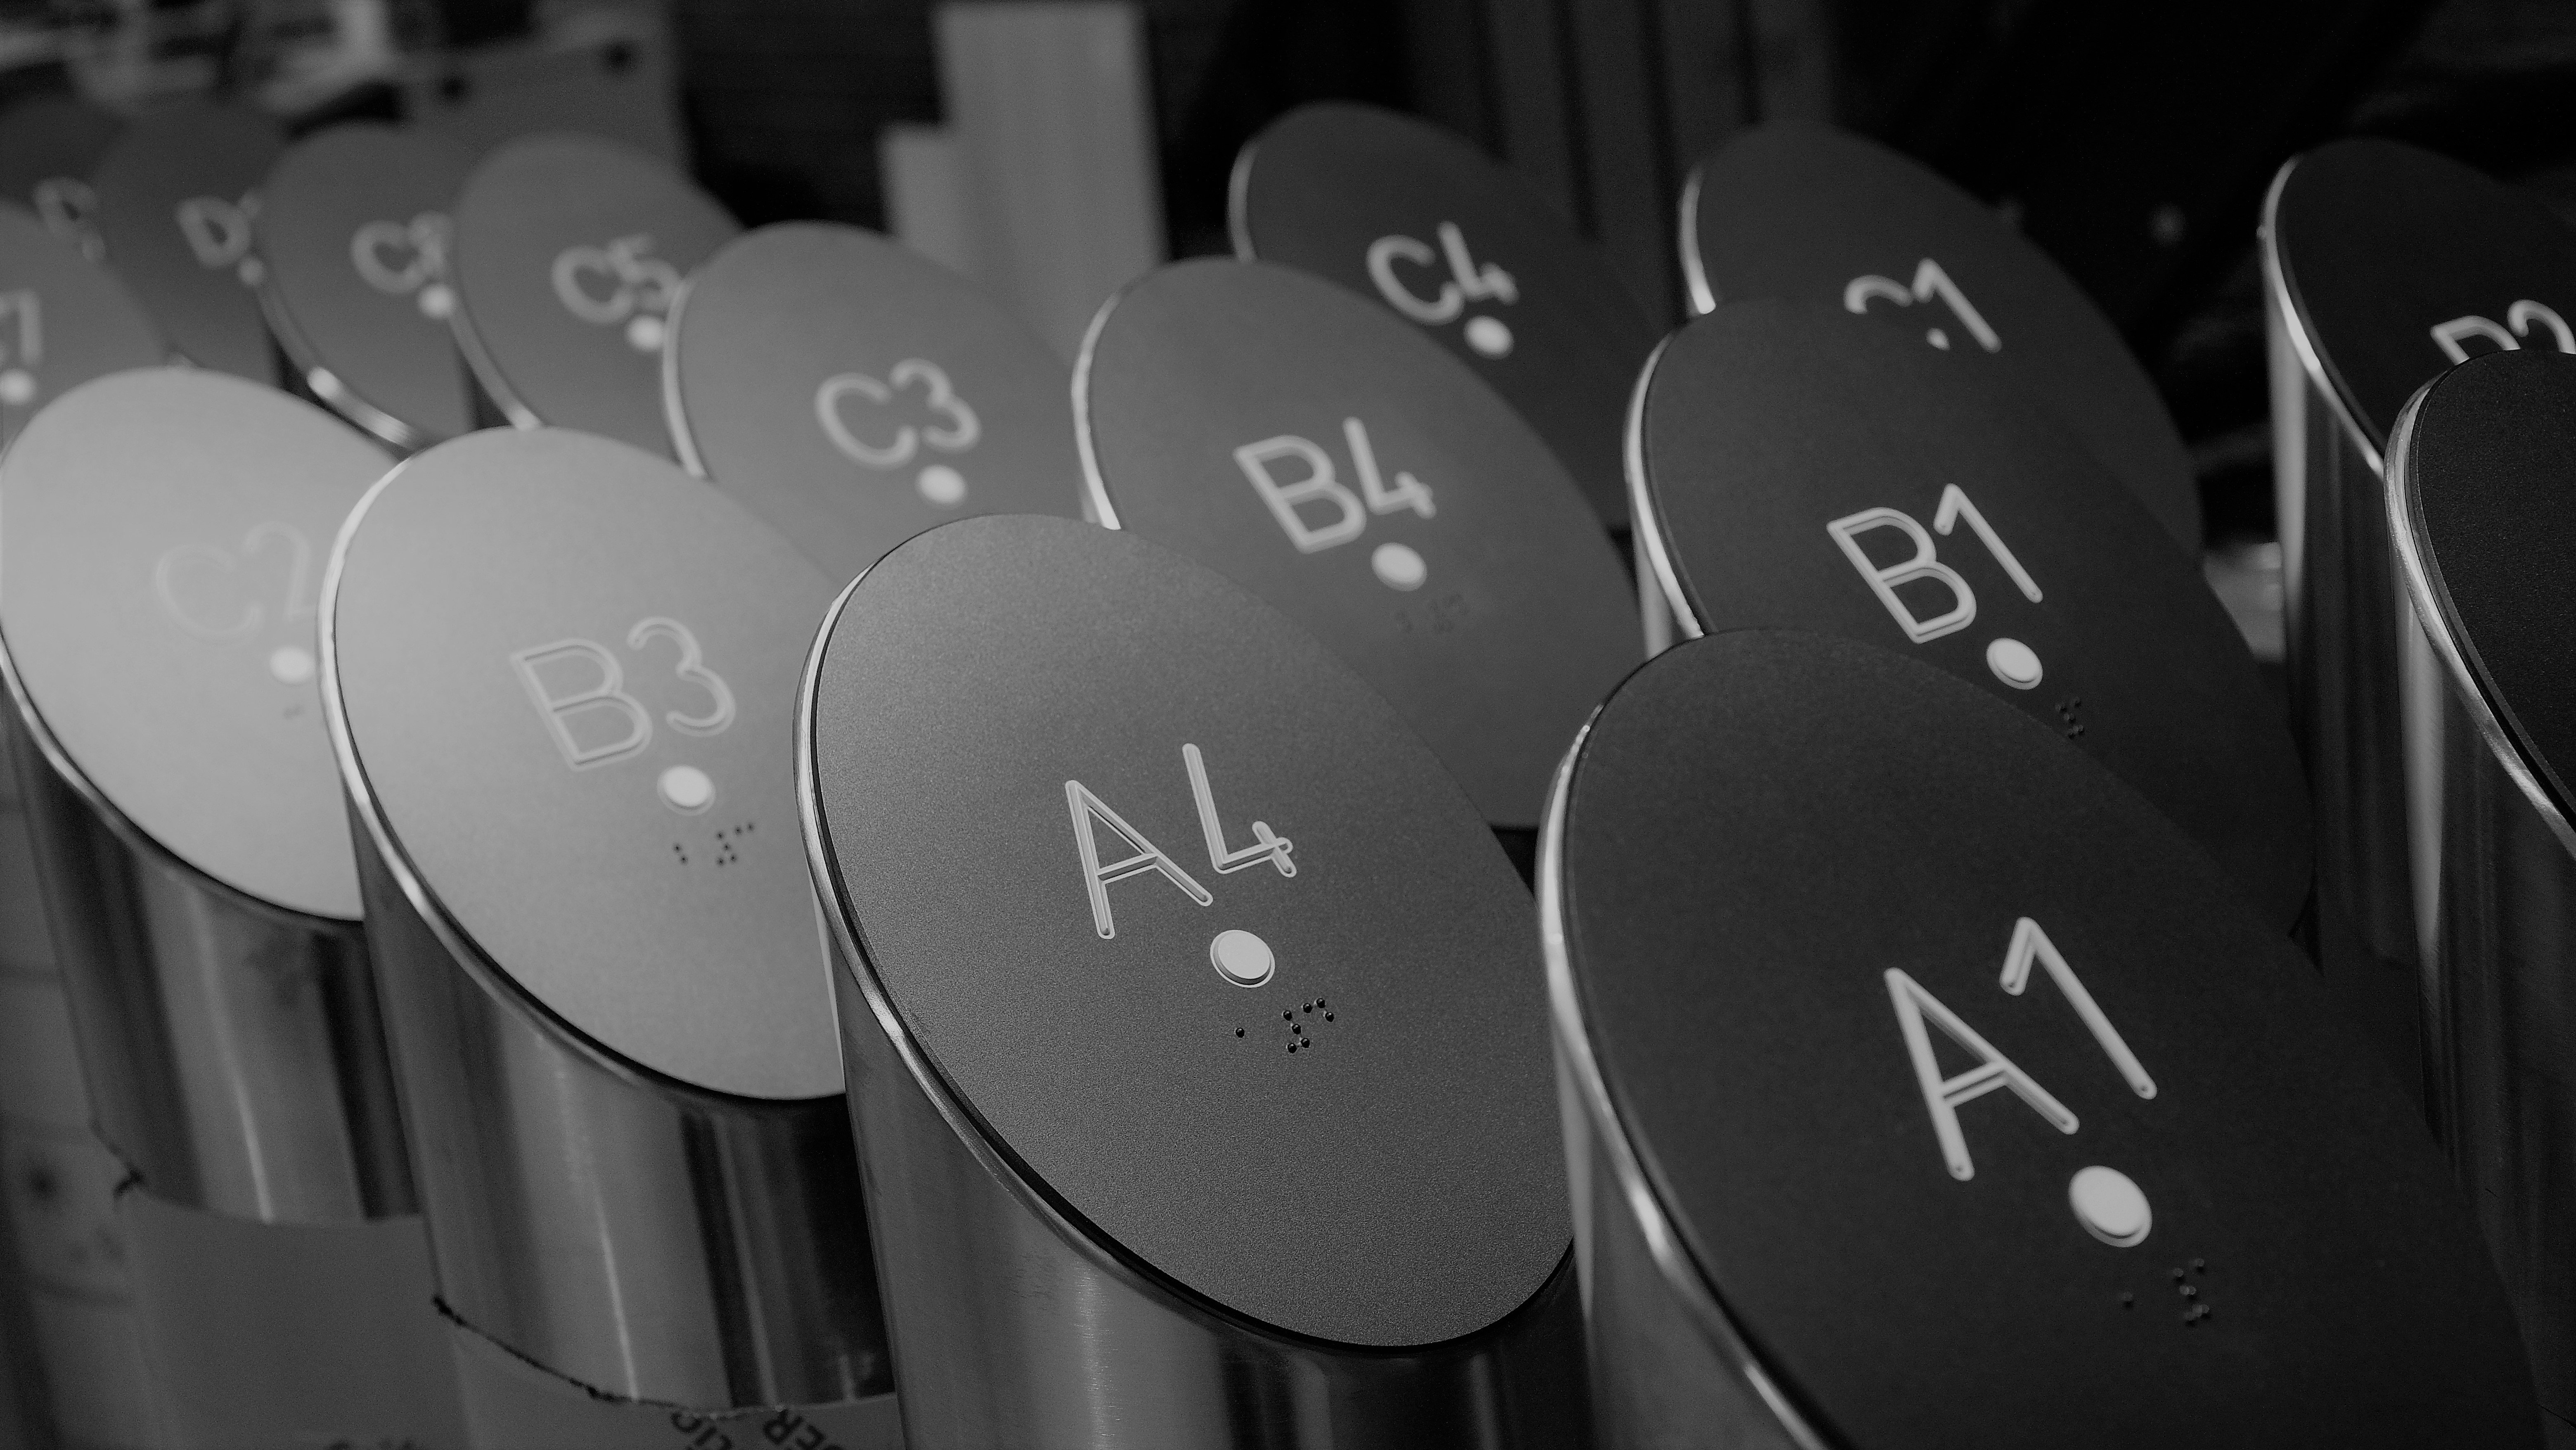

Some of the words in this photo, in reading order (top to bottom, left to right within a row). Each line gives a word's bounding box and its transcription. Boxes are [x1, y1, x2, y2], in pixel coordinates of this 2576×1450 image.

[1367, 220, 1519, 325] C4
[815, 358, 981, 470] C3
[1233, 416, 1437, 554] B4
[155, 520, 318, 644] C2
[1826, 483, 2043, 644] B1
[510, 617, 736, 771] B3
[1065, 743, 1297, 939] A4
[1884, 917, 2157, 1182] A1
